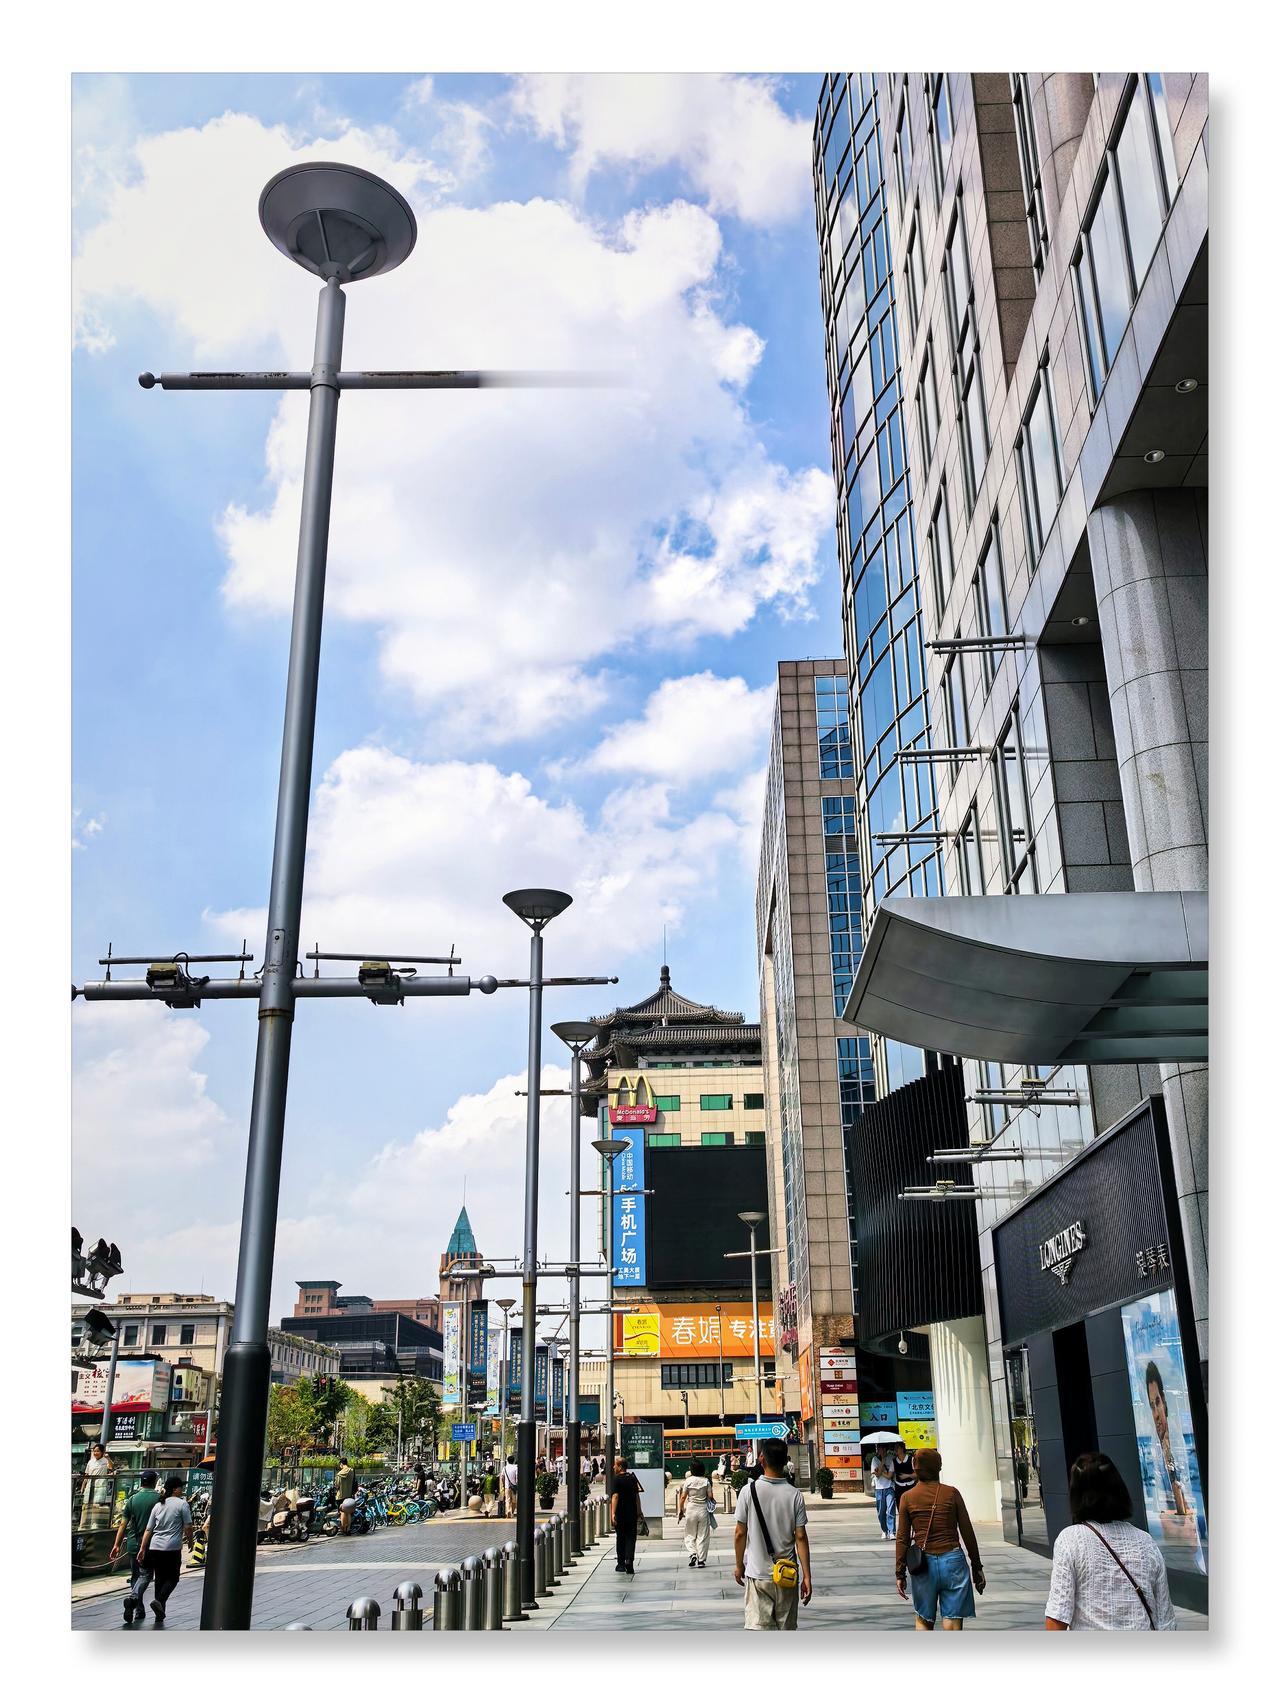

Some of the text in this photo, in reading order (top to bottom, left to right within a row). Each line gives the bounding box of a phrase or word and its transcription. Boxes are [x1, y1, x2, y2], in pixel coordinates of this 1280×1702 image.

[626, 1152, 634, 1181] 中国移动
[620, 1197, 637, 1264] 手机广场
[1039, 1221, 1085, 1271] LONGINES
[671, 1316, 721, 1345] 春娟
[870, 1413, 888, 1422] 入口
